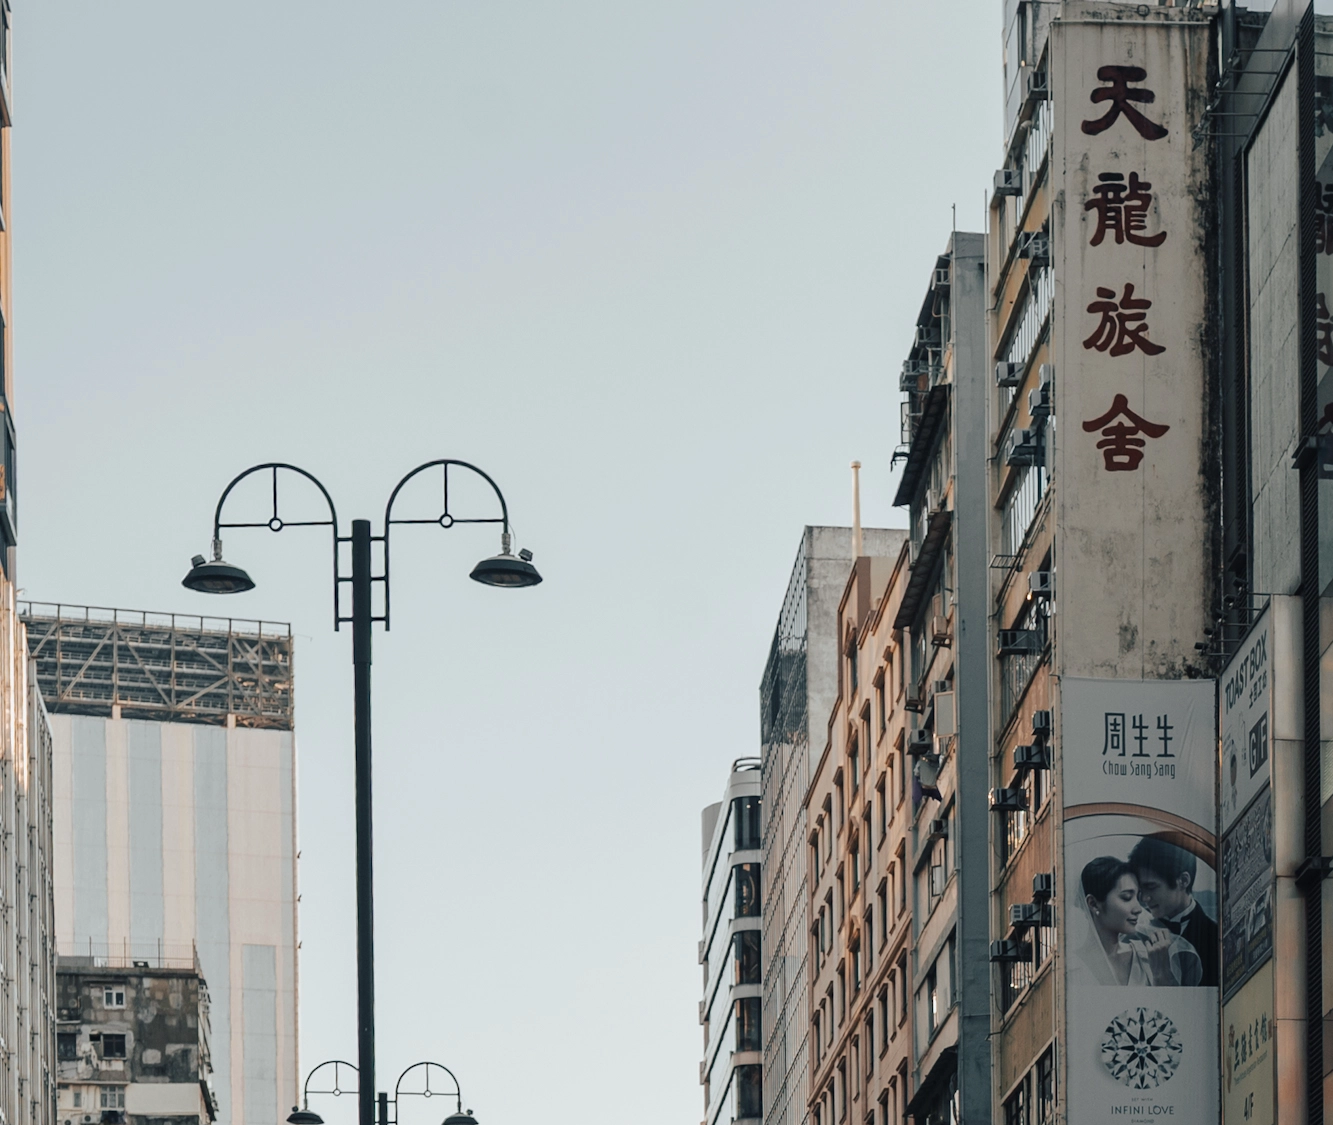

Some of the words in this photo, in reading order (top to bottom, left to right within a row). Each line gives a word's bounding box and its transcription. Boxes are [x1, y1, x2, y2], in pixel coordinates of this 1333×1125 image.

[1081, 65, 1170, 472] 天龍旅舍
[1225, 655, 1249, 715] TOAST
[1250, 629, 1267, 682] BOX
[1102, 712, 1175, 757] 周生生
[1102, 760, 1127, 775] Chow
[1130, 760, 1151, 779] Sang
[1154, 760, 1176, 779] Sang
[1111, 1105, 1144, 1115] INFINI
[1148, 1105, 1175, 1115] LOVE
